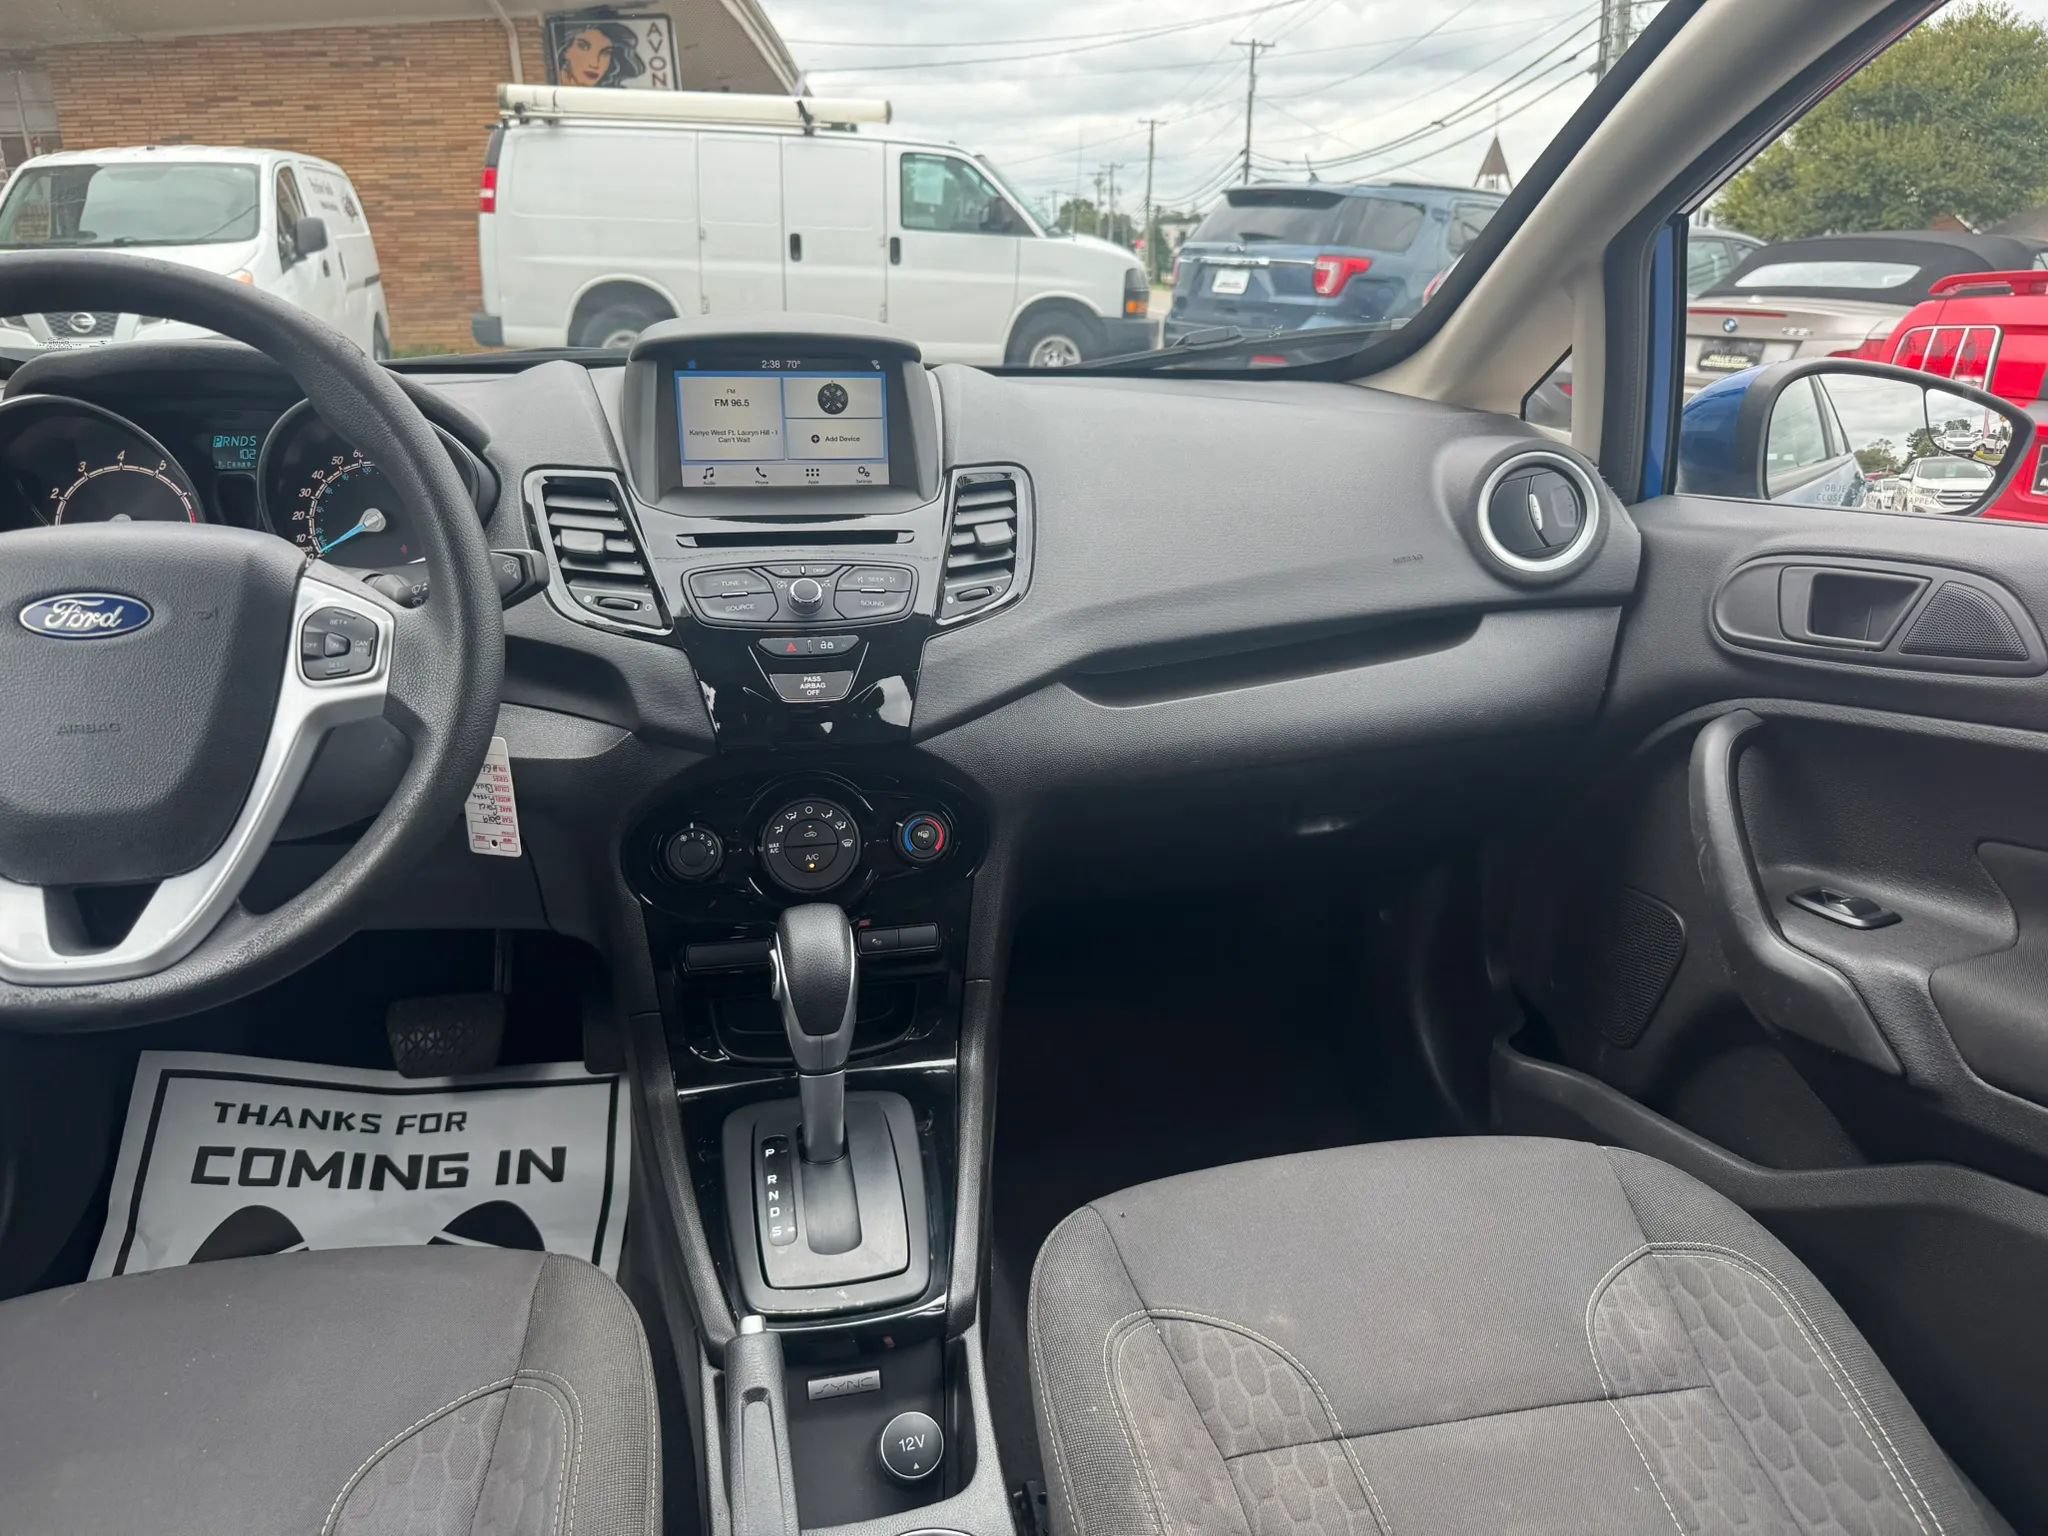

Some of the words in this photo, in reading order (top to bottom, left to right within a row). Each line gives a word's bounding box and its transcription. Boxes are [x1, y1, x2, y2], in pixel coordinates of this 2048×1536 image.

[646, 21, 667, 88] AVON
[761, 359, 780, 369] 2:38
[786, 360, 801, 369] 70°
[714, 399, 729, 407] FM
[730, 399, 750, 407] 96.5
[689, 430, 709, 438] Kanye
[737, 430, 759, 438] Lauryn
[117, 450, 126, 461] 4
[331, 455, 344, 465] 50
[77, 461, 87, 473] 3
[159, 459, 167, 471] 5
[311, 470, 324, 480] 40
[50, 487, 60, 499] 2
[298, 488, 312, 498] 30
[291, 511, 305, 521] 20
[296, 533, 307, 543] 10
[726, 604, 755, 612] SOURCE
[861, 600, 885, 608] SOUND
[44, 599, 124, 628] Ford
[799, 682, 826, 690] AIRBAG
[57, 722, 121, 735] AIRBAG
[805, 853, 819, 861] A/C
[214, 1101, 382, 1134] THANKS
[395, 1111, 468, 1136] FOR
[765, 1148, 775, 1157] P
[190, 1146, 470, 1192] COMING
[495, 1146, 567, 1186] IN
[767, 1175, 777, 1184] R
[769, 1191, 779, 1200] N
[770, 1207, 780, 1217] D
[771, 1226, 782, 1236] S
[814, 1376, 877, 1395] SYNC
[898, 1434, 925, 1453] 12V
